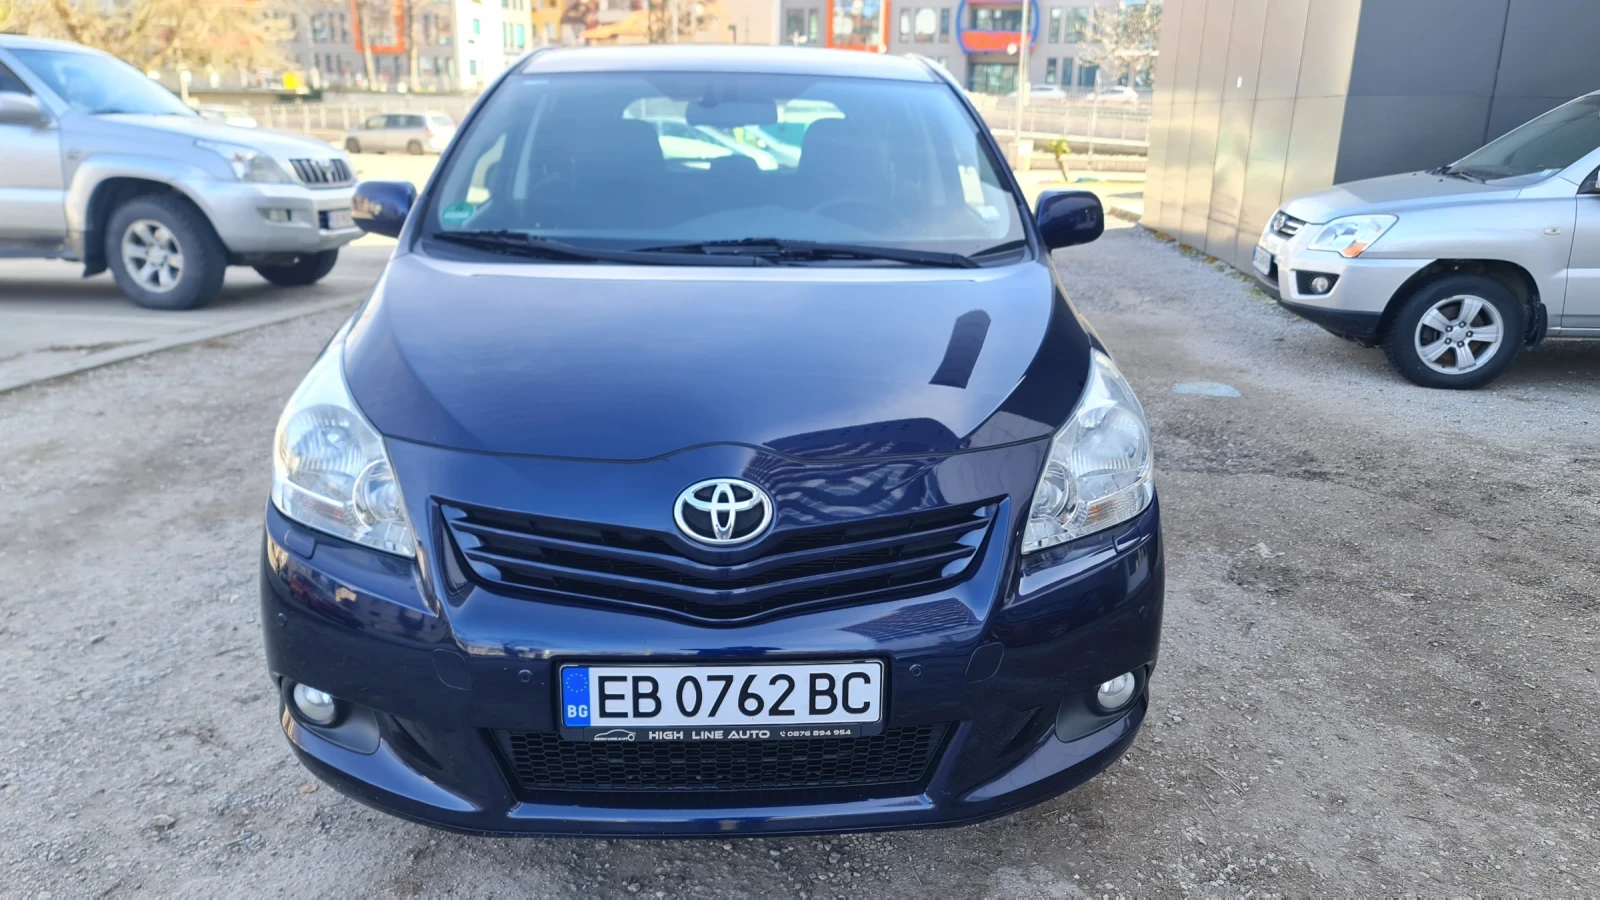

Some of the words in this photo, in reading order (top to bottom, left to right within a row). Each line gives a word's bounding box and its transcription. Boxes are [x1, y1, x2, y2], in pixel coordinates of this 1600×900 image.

[597, 675, 662, 719] EB
[675, 673, 796, 718] 0762
[808, 671, 871, 716] BC
[567, 704, 588, 718] BG
[648, 730, 684, 740] HIGH
[691, 730, 724, 740] LINE
[727, 729, 771, 740] AUTO
